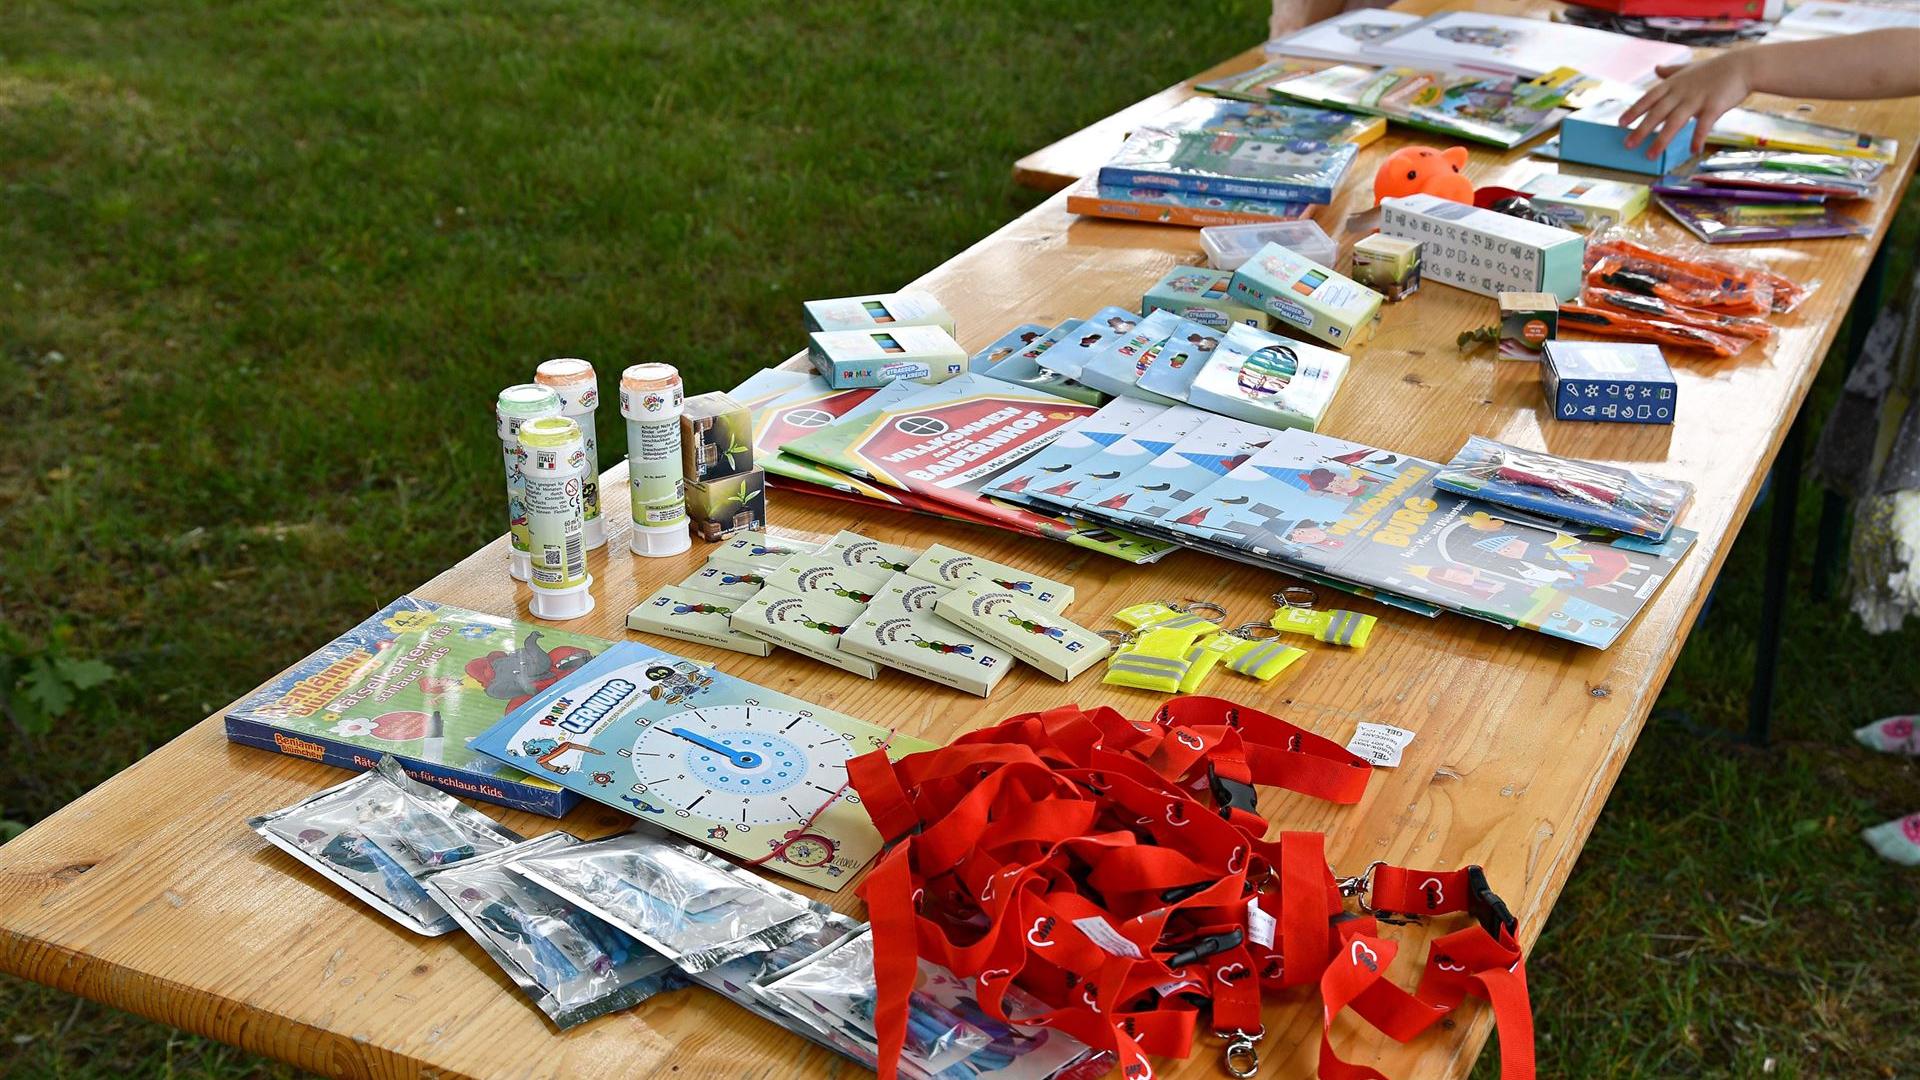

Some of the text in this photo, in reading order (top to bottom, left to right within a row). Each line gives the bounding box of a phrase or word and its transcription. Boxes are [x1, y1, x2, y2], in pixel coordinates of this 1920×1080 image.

[1273, 301, 1304, 316] STRASSEN-
[1280, 310, 1313, 326] MALKREIDE
[843, 368, 872, 379] PRIMAX
[882, 406, 1024, 463] WILLKOMMEN
[906, 411, 1048, 481] BAUERNHOF
[538, 456, 554, 464] ITALY
[1007, 452, 1021, 460] und
[1373, 497, 1438, 548] BURG
[325, 637, 434, 713] Rätselkarten
[376, 646, 450, 704] schlaue Kids
[559, 679, 636, 734] LERNUHR
[634, 718, 650, 726] 12
[1386, 728, 1402, 736] GEL
[275, 733, 325, 753] Benjamin
[1373, 751, 1390, 760] GEL
[420, 769, 438, 783] für
[438, 773, 477, 792] schlaue
[479, 785, 504, 799] Kids
[630, 783, 648, 793] 10
[674, 809, 691, 817] 9
[734, 823, 750, 831] 8
